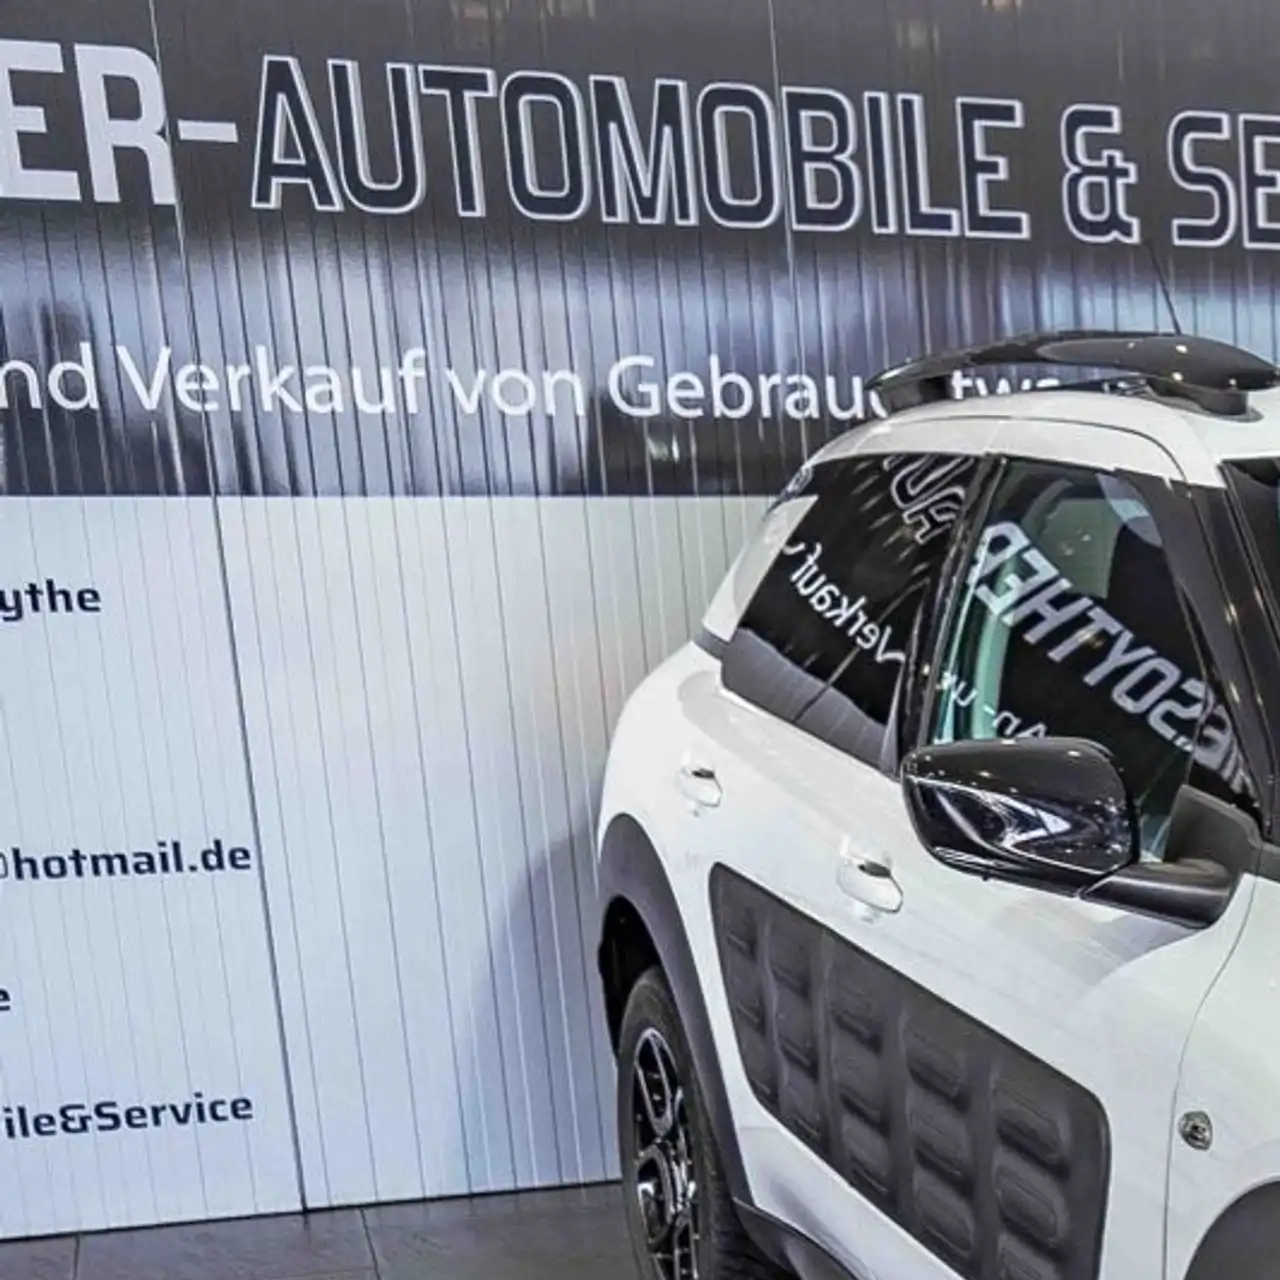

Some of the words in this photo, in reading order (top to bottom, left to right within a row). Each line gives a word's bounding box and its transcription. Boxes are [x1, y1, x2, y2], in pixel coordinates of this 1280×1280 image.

[1062, 104, 1140, 243] &
[117, 346, 426, 414] Verkauf
[448, 369, 585, 416] von
[4, 1091, 253, 1140] ile&Service
